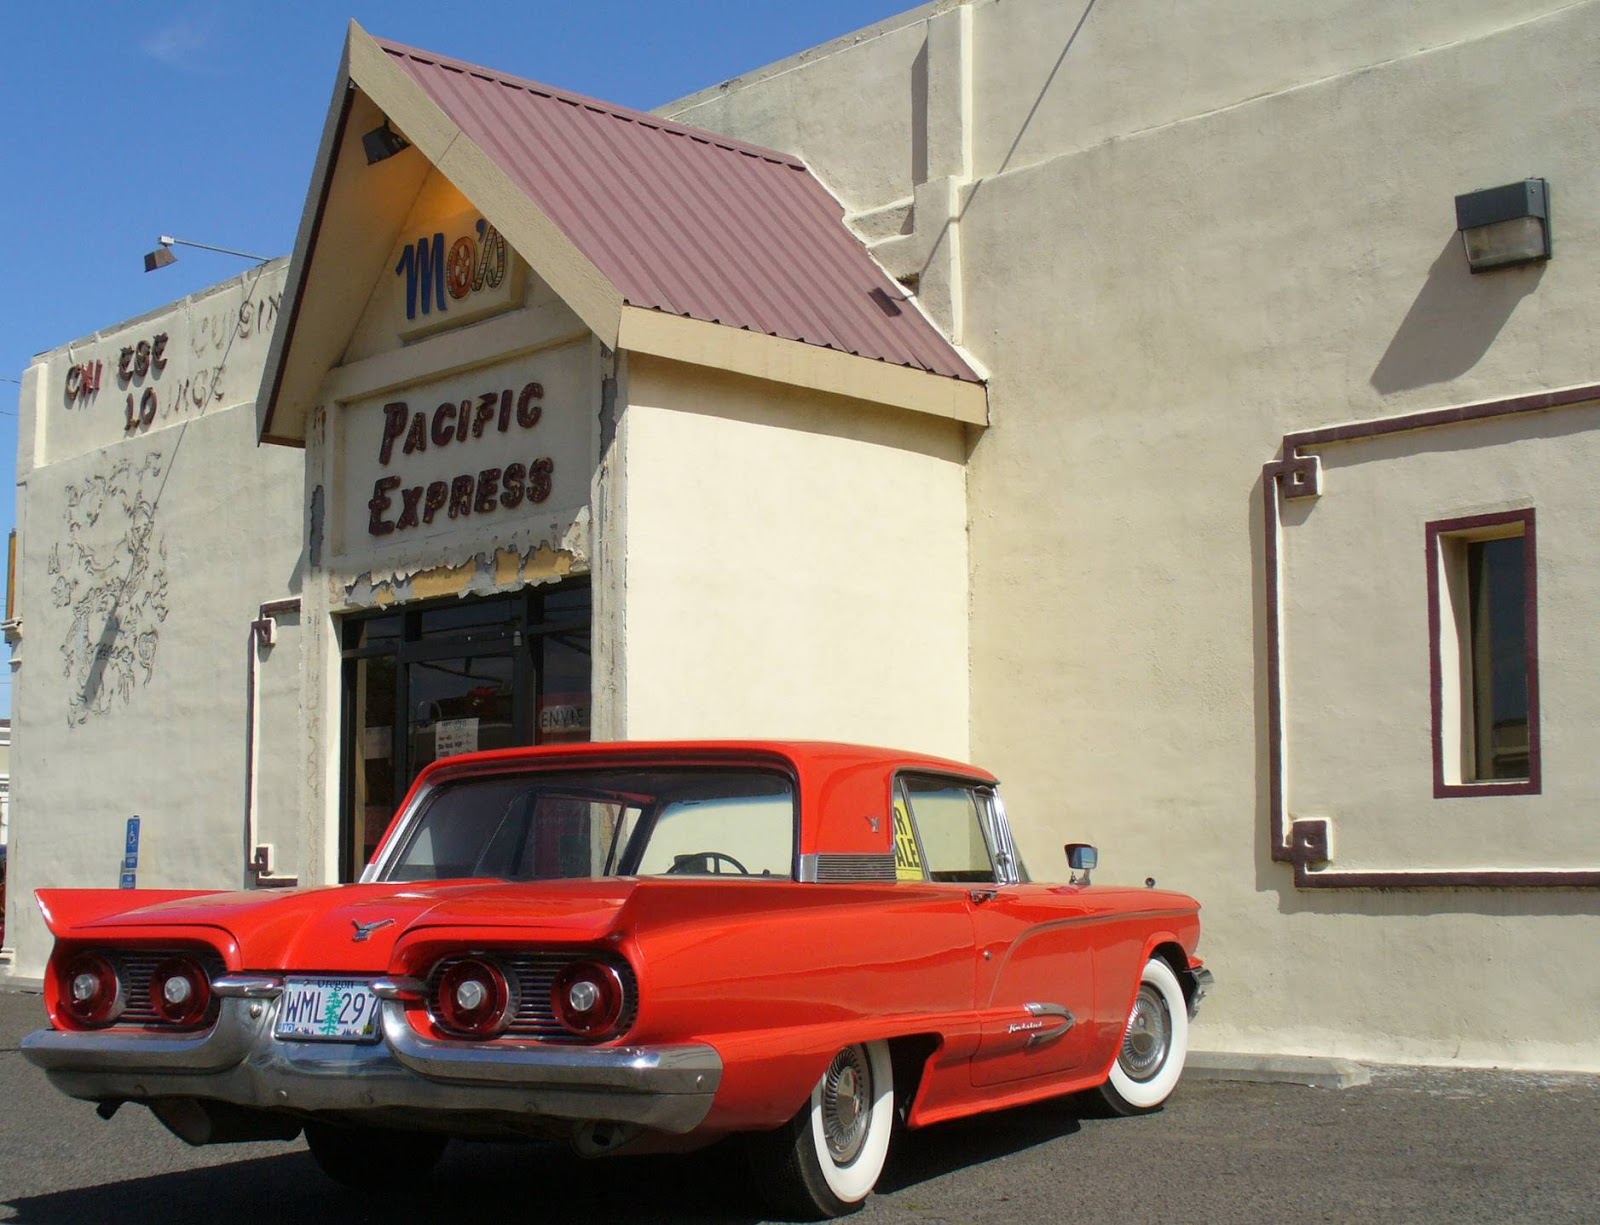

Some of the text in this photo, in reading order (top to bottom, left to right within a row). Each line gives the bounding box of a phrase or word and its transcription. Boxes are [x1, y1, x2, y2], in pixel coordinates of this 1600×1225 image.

[395, 218, 506, 320] Mo's
[378, 382, 544, 466] PACIFIC
[367, 457, 555, 536] EXPRESS
[285, 990, 379, 1027] WML 297
